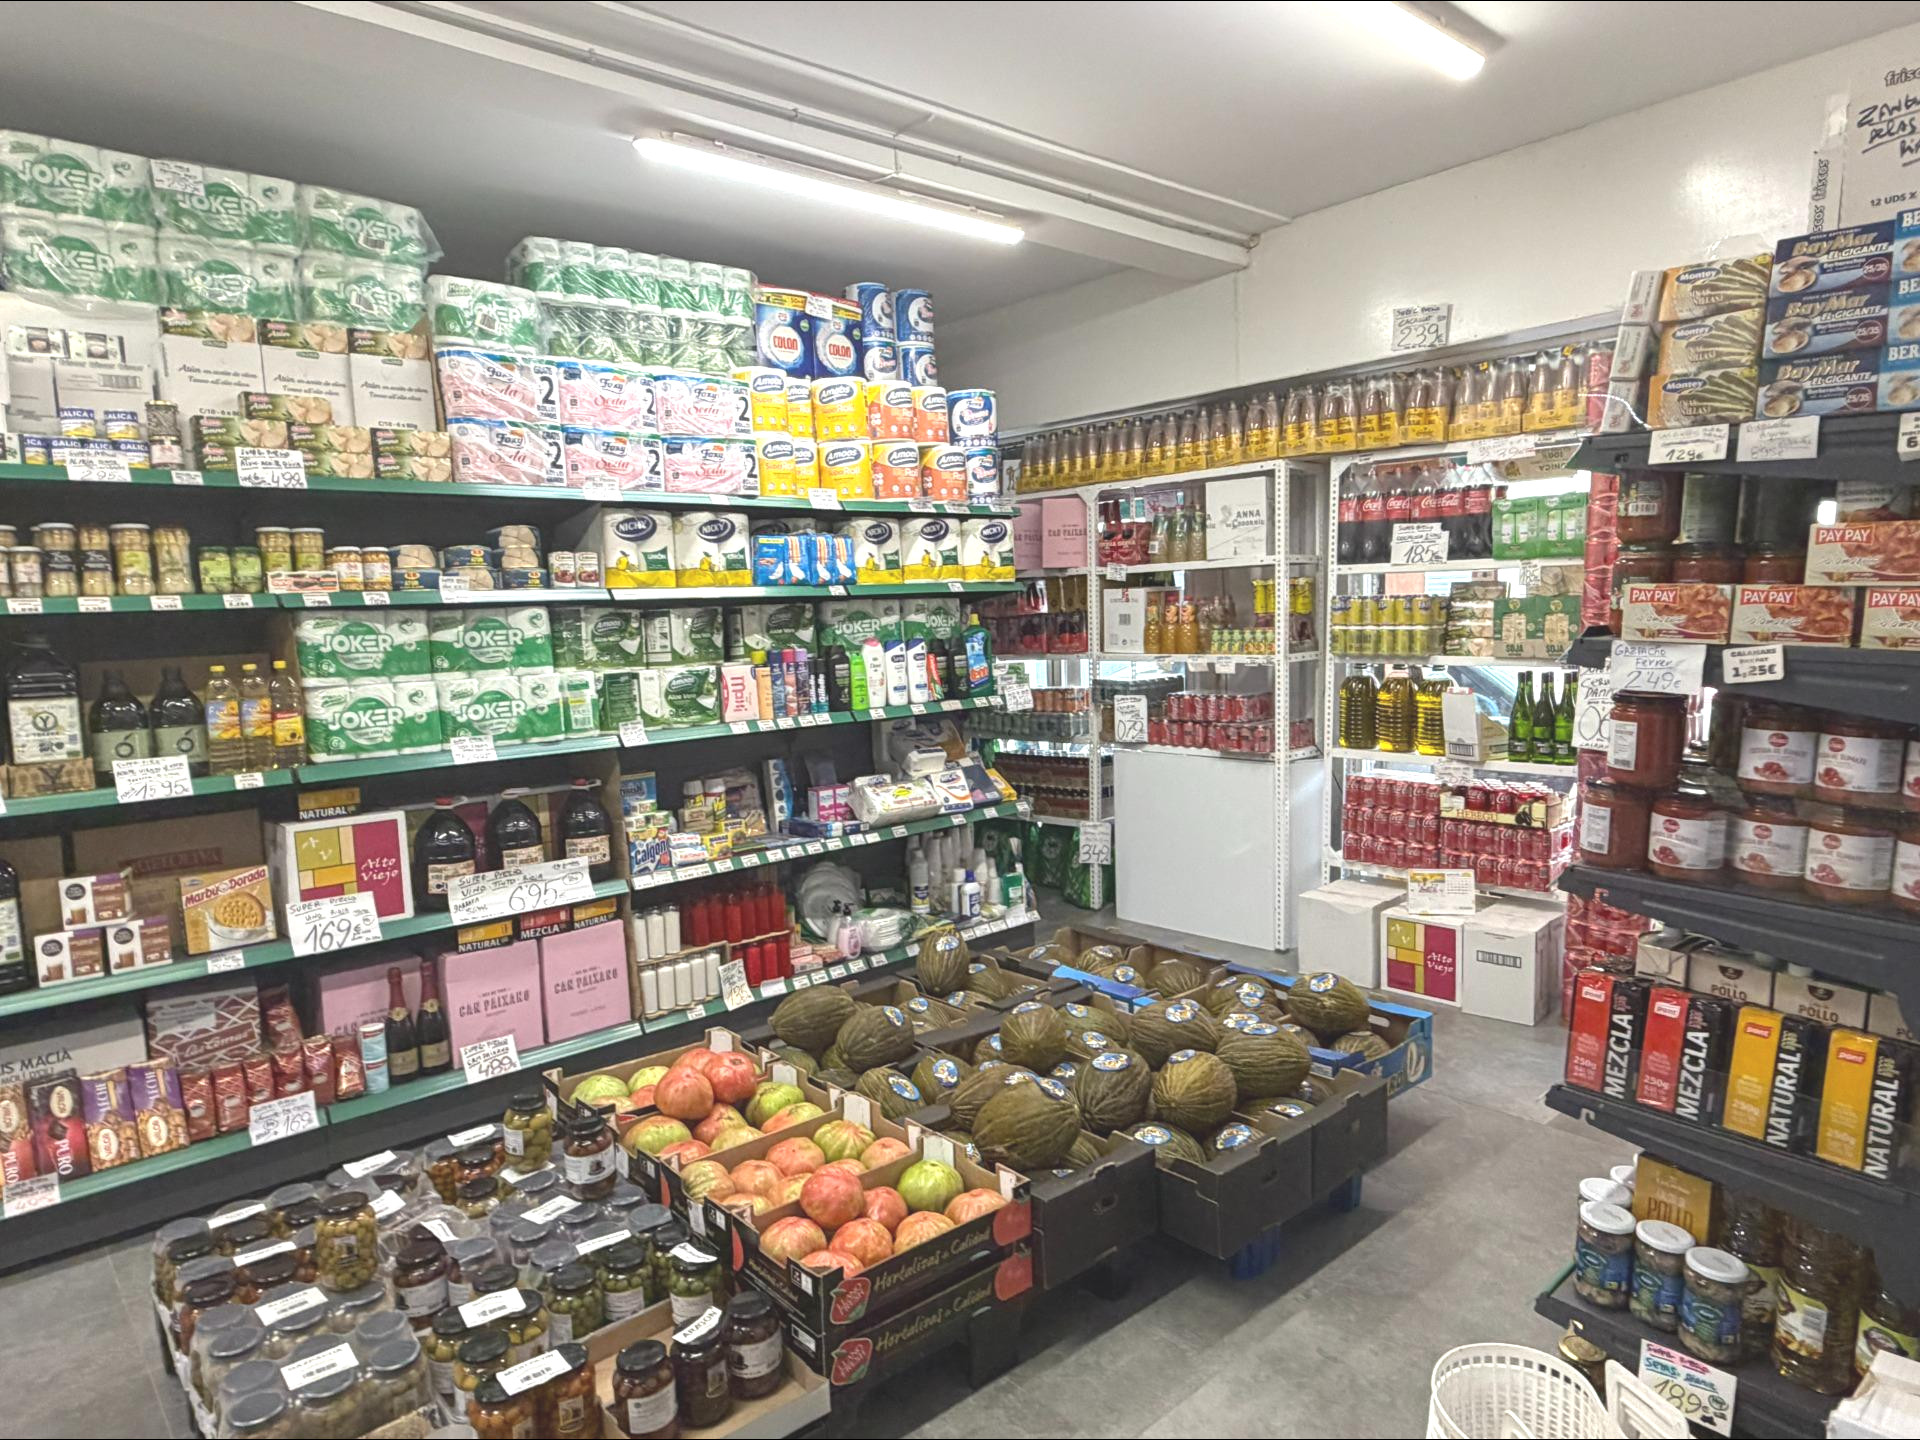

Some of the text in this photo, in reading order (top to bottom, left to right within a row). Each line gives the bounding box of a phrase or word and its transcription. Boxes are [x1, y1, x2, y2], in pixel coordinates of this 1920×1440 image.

[18, 161, 103, 191] JOKER
[179, 193, 259, 216] JOKER
[1885, 194, 1906, 205] UDS
[26, 243, 113, 274] JOKER
[1841, 243, 1890, 258] GIGANTE
[1836, 305, 1882, 318] GIGANTE
[773, 335, 799, 350] COLON
[829, 343, 853, 358] COLON
[1825, 372, 1872, 384] GIGANTE
[827, 449, 859, 461] Amoos
[1236, 509, 1261, 518] ANNA
[1818, 529, 1871, 541] PAY PAY
[1631, 590, 1677, 602] PAY PAY
[1743, 591, 1793, 603] PAY PAY
[1872, 592, 1897, 605] PAY
[834, 617, 880, 635] JOKER
[320, 632, 394, 654] JOKER
[453, 627, 524, 648] JOKER
[1635, 658, 1672, 668] Ferrer
[328, 706, 404, 729] JOKER
[456, 699, 527, 721] JOKER
[299, 806, 347, 821] NATURAL
[635, 842, 668, 865] Calgon
[362, 856, 397, 870] Alto
[229, 867, 268, 891] Dorada
[360, 867, 400, 883] Viejo
[289, 900, 321, 914] SUPER
[574, 914, 609, 930] NATURAL
[521, 923, 560, 940] MEZCLA
[458, 938, 501, 953] NATURAL
[1711, 983, 1747, 1001] POLLO
[1798, 1004, 1840, 1024] POLLO
[1603, 1014, 1634, 1100] MEZCLA
[1675, 1031, 1710, 1122] MEZCLA
[1766, 1052, 1802, 1148] NATURAL
[1863, 1079, 1900, 1181] NATURAL
[55, 1139, 73, 1175] PURO
[2, 1151, 19, 1184] PURO
